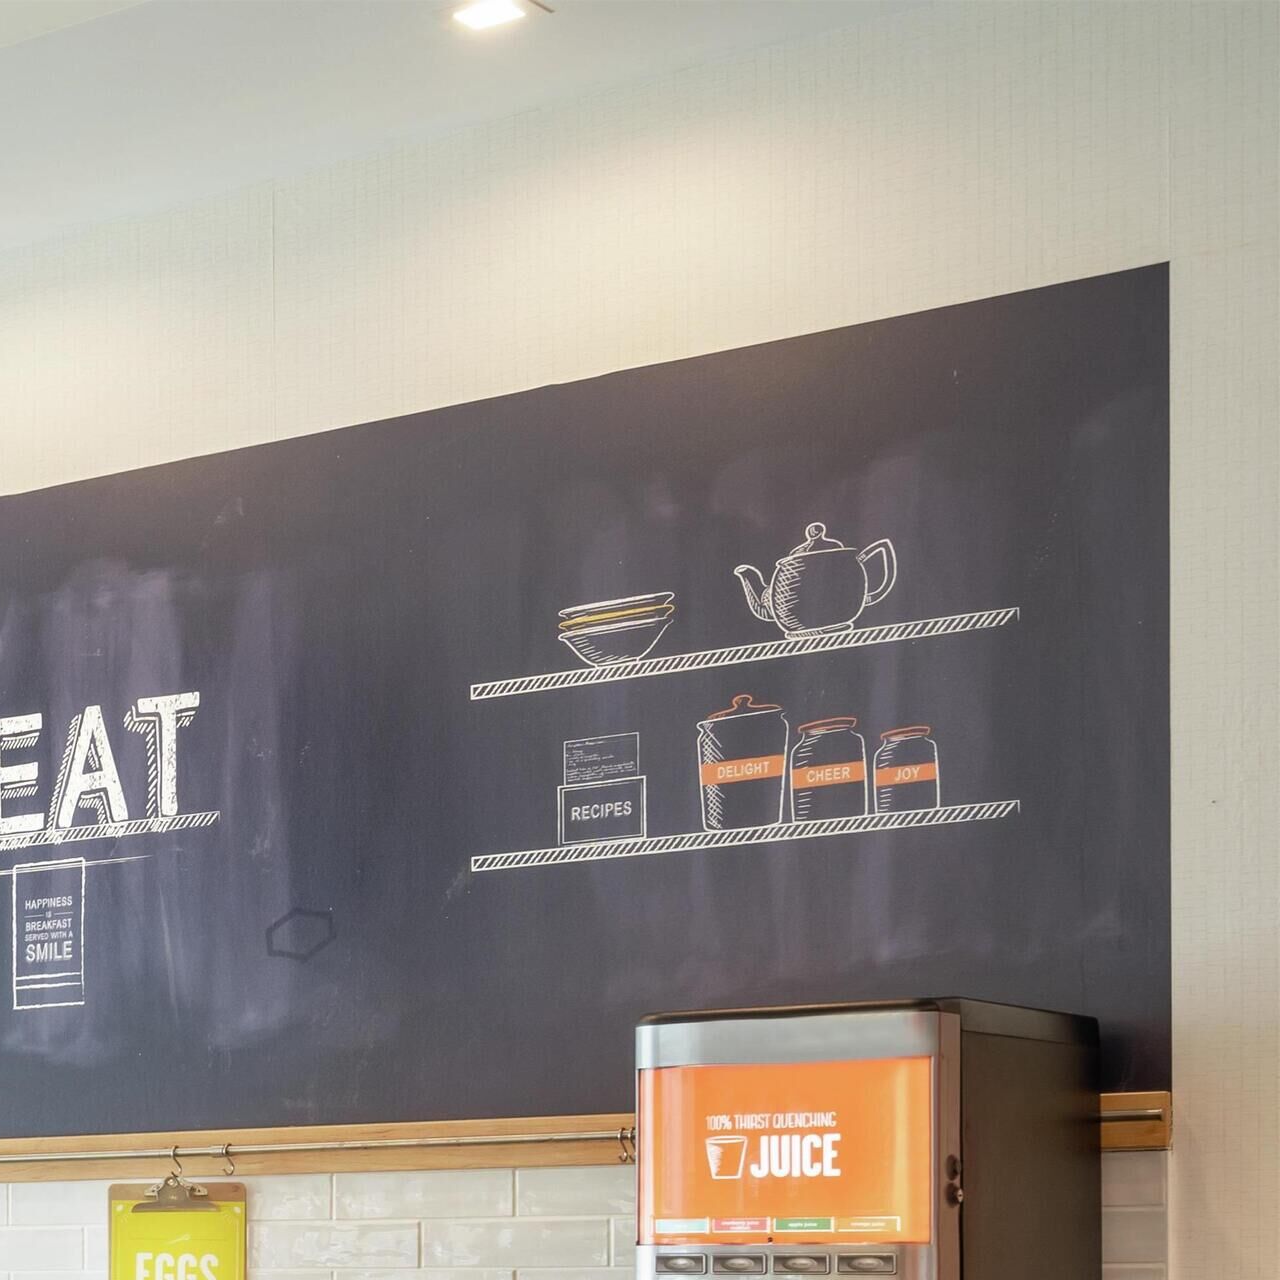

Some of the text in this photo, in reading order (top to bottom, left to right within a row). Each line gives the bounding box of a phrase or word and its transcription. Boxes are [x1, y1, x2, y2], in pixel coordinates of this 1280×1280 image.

[716, 761, 770, 780] DELIGHT
[806, 766, 851, 783] CHEER
[894, 767, 920, 782] JOY
[571, 800, 633, 821] RECIPES
[24, 896, 73, 911] HAPPINESS
[25, 918, 73, 932] BREAKFAST
[24, 930, 74, 942] SERVED WITH A
[25, 940, 73, 963] SMILE
[706, 1111, 837, 1130] 100% THIRST QUENCHING
[750, 1133, 841, 1178] JUICE
